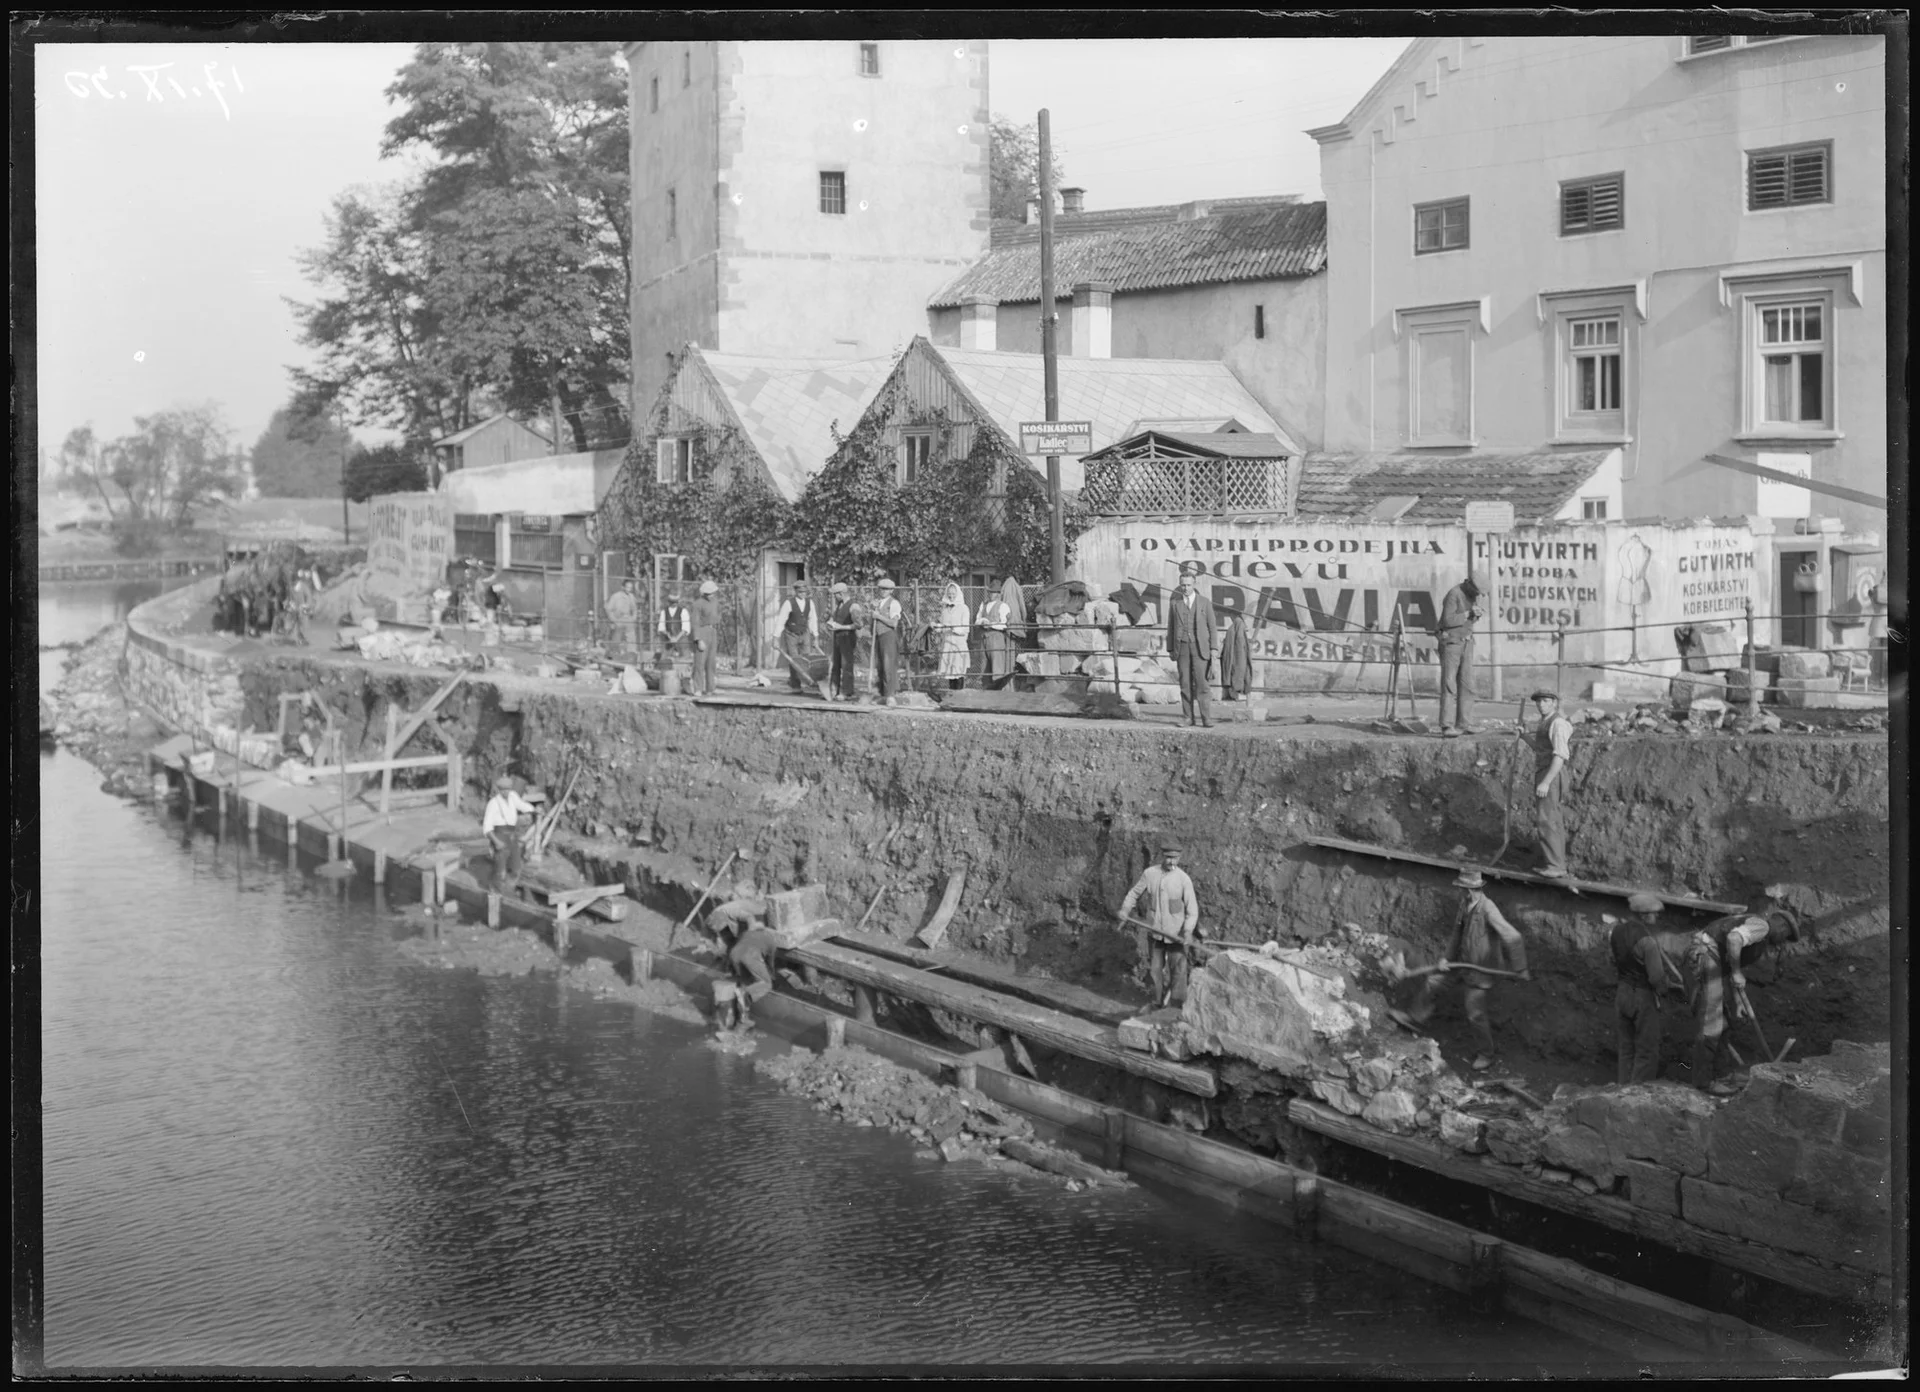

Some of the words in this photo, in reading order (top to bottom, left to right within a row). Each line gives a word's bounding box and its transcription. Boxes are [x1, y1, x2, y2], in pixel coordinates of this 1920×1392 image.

[1119, 532, 1260, 552] TOVÁRNÍ
[1268, 539, 1445, 562] PRODEJNA
[1498, 541, 1598, 560] UTVIRTH
[1178, 554, 1351, 580] oděvů
[1678, 551, 1754, 573] GUTVIRTH
[1120, 582, 1439, 632] MRAVIA
